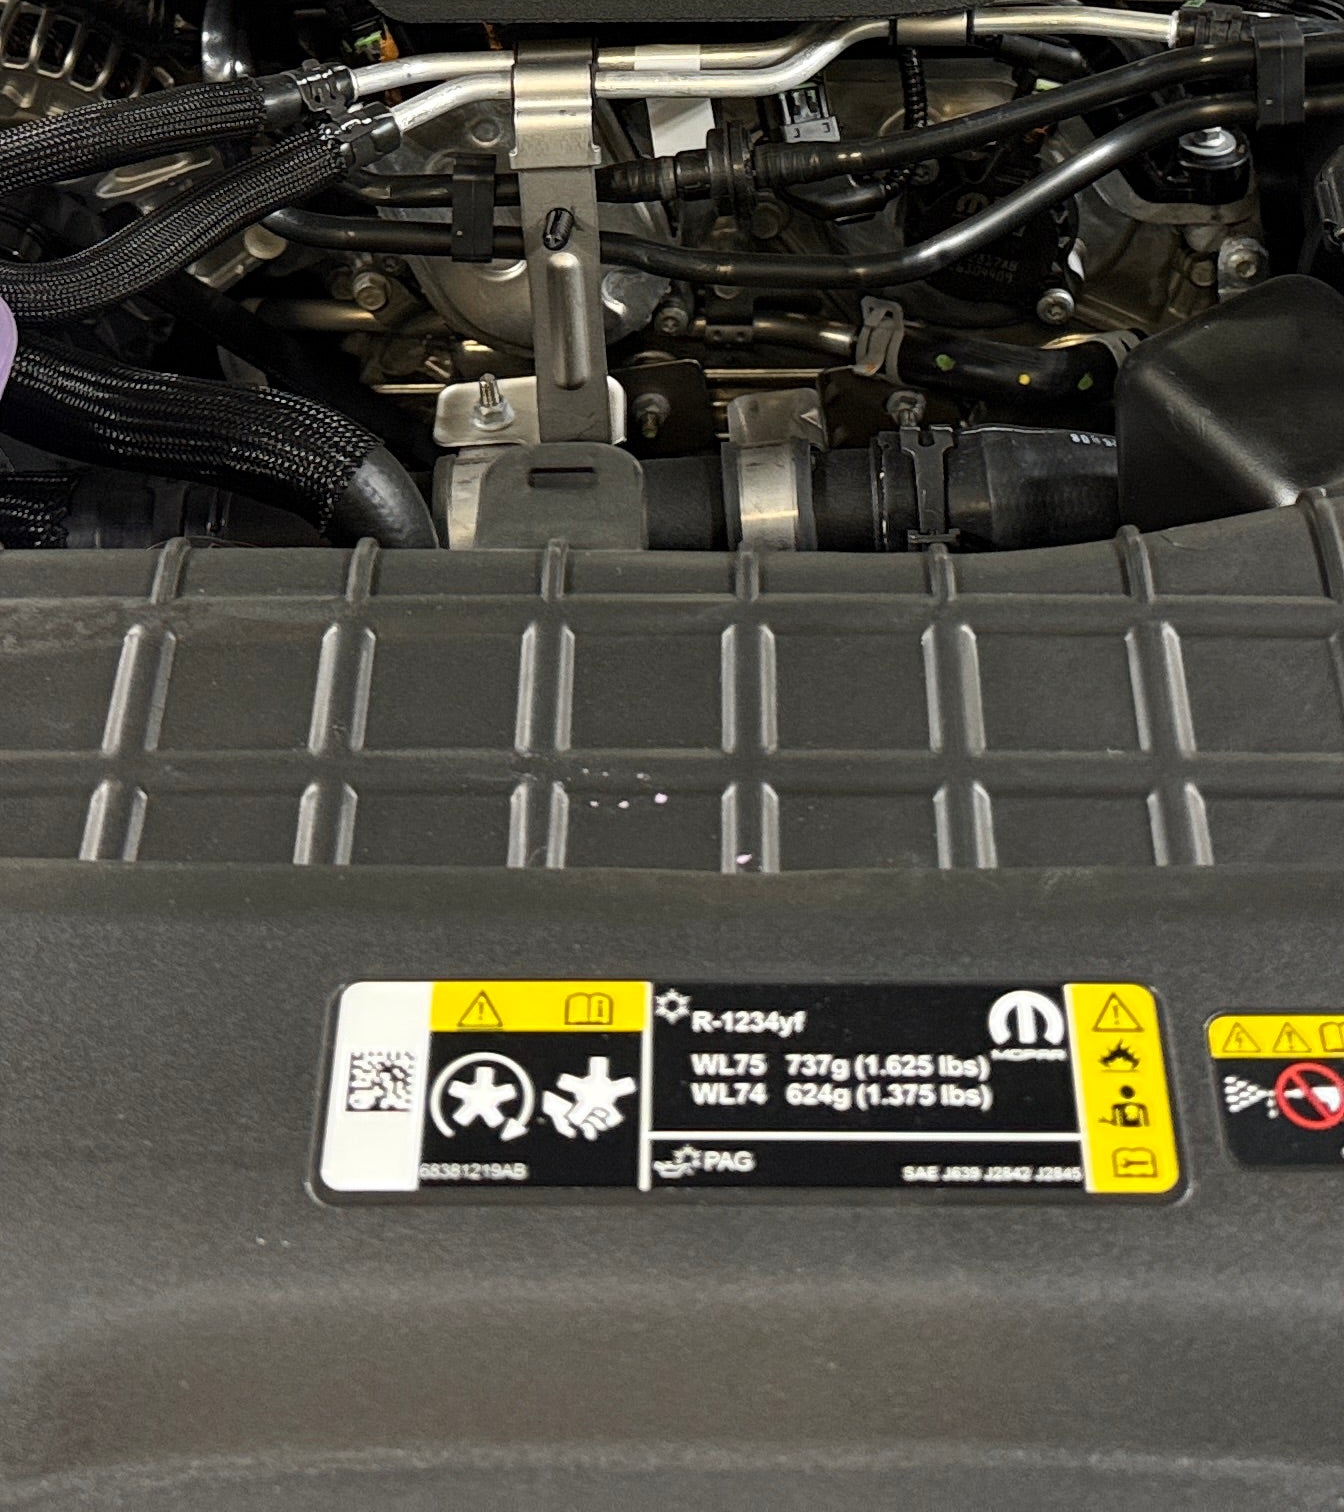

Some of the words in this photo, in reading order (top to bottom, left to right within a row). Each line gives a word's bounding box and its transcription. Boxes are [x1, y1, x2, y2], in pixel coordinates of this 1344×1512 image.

[691, 1010, 806, 1038] R-1234yf
[991, 1049, 1066, 1061] MOPAR
[690, 1053, 768, 1076] WL75
[784, 1053, 850, 1082] 737g
[855, 1054, 934, 1081] (1.625
[938, 1054, 991, 1082] lbs)
[690, 1082, 769, 1106] WL74
[785, 1082, 853, 1111] 624g
[856, 1083, 937, 1111] (1.375
[939, 1083, 994, 1112] lbs)
[703, 1151, 755, 1172] PAG
[902, 1166, 940, 1182] SAE
